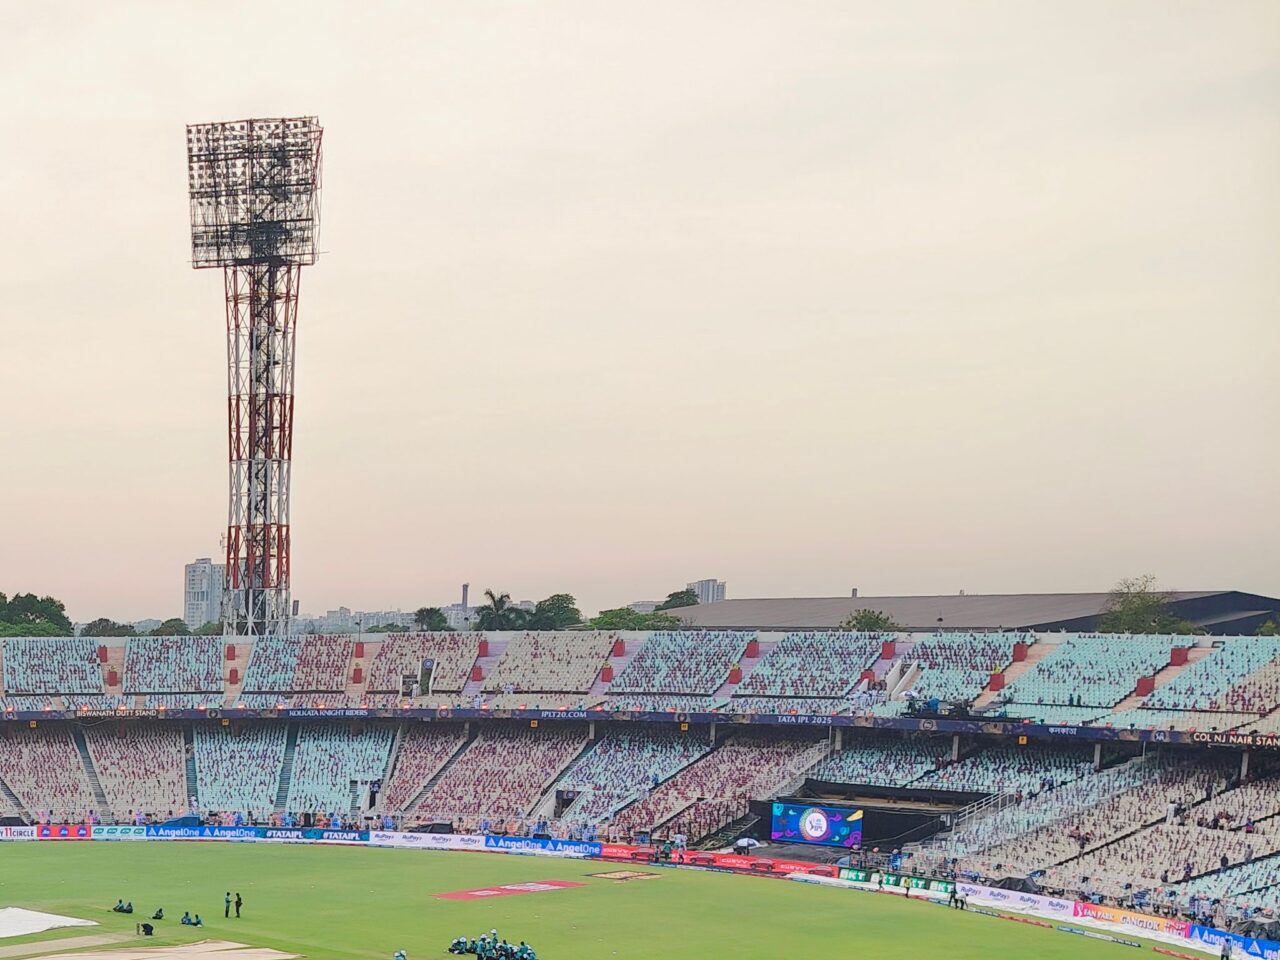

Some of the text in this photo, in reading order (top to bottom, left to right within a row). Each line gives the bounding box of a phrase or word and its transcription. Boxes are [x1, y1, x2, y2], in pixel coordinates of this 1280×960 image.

[76, 708, 157, 718] BISWANATH DUTT STAND
[289, 708, 368, 717] KOLKATA KNIGHT RIDERS
[541, 710, 587, 719] IPLT20.COM
[777, 715, 797, 723] TATA
[811, 716, 832, 724] 2025
[1194, 732, 1211, 742] COL
[1214, 733, 1226, 743] NJ
[1229, 735, 1253, 744] NAIR
[157, 827, 199, 837] AngelOne
[213, 828, 256, 838] AngelOne
[266, 830, 303, 839] #TATAIPL
[323, 831, 361, 840] #TATAIPL
[498, 838, 542, 850] AngelOne
[556, 842, 600, 854] AngelOne
[841, 869, 866, 880] BKT
[1097, 911, 1115, 921] PARK
[1120, 916, 1160, 930] GANGTOK
